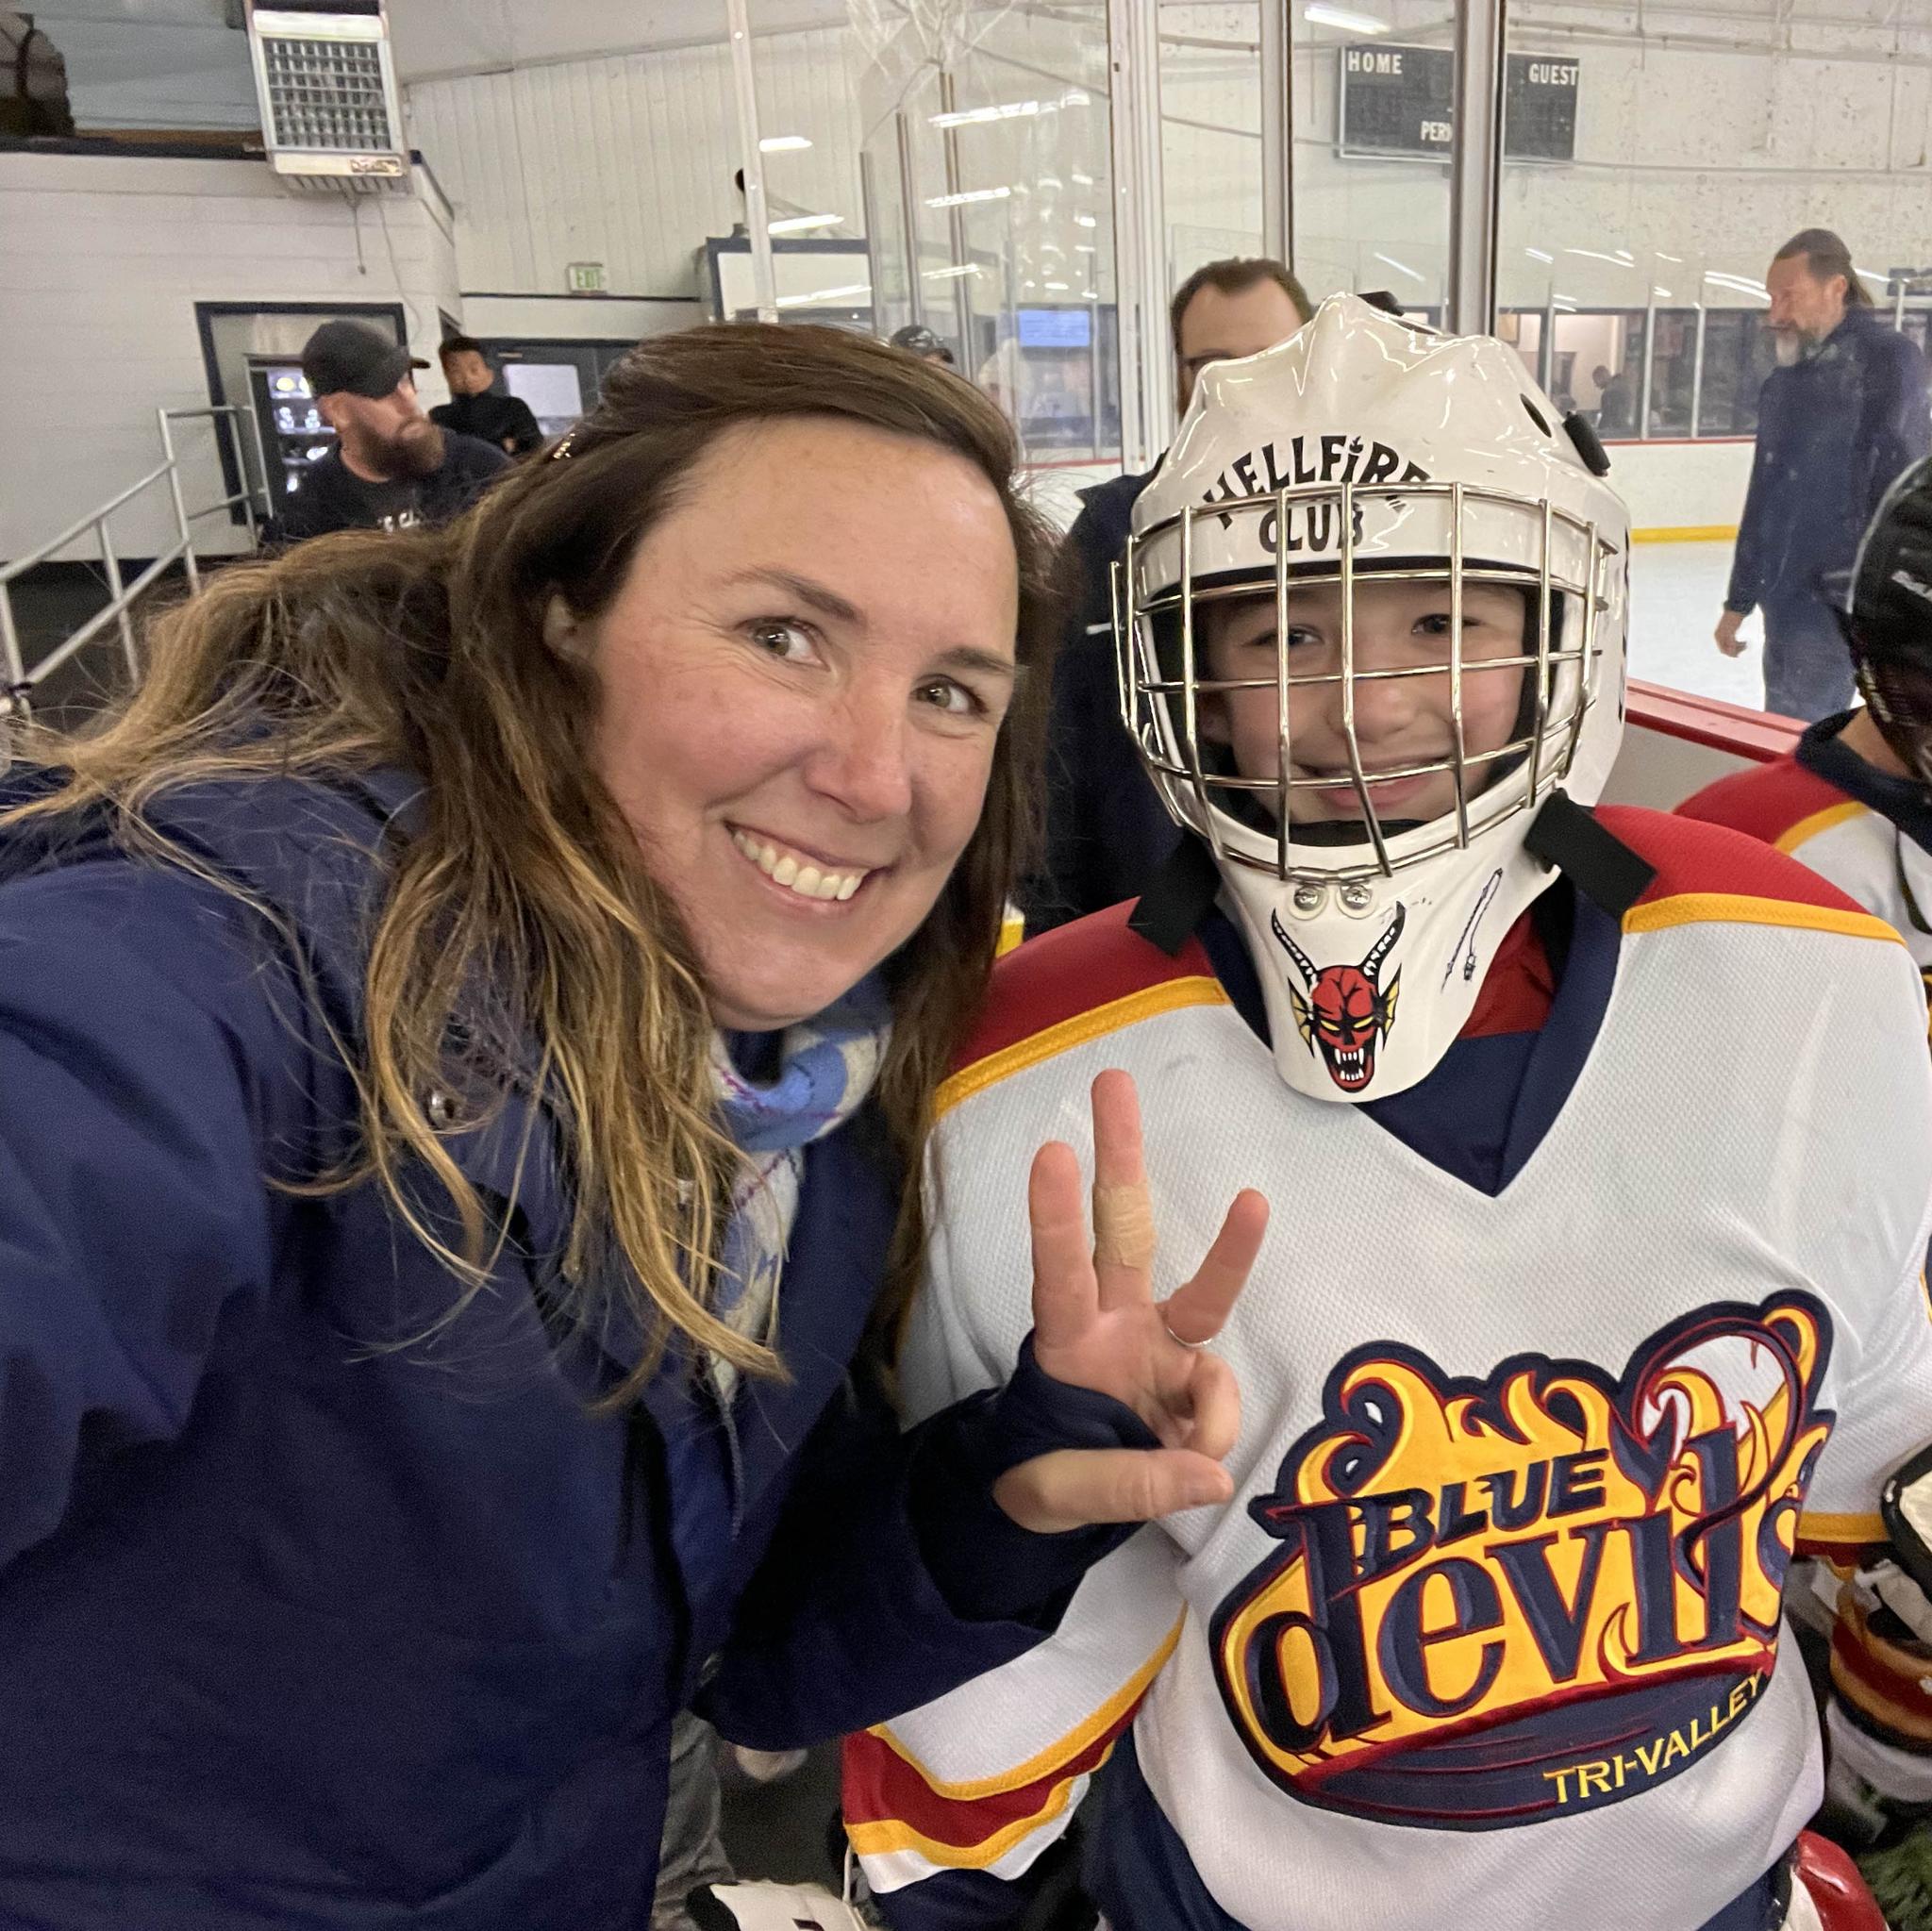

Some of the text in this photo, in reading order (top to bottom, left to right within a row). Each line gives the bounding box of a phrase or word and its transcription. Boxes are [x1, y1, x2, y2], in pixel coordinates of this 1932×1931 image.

[1347, 51, 1403, 75] HOME
[1528, 63, 1579, 86] GUEST
[1421, 121, 1453, 141] PERI
[1258, 502, 1364, 552] CLUB
[1346, 1447, 1610, 1577] BLUE
[1542, 1667, 1763, 1804] TRI-VALLEY
